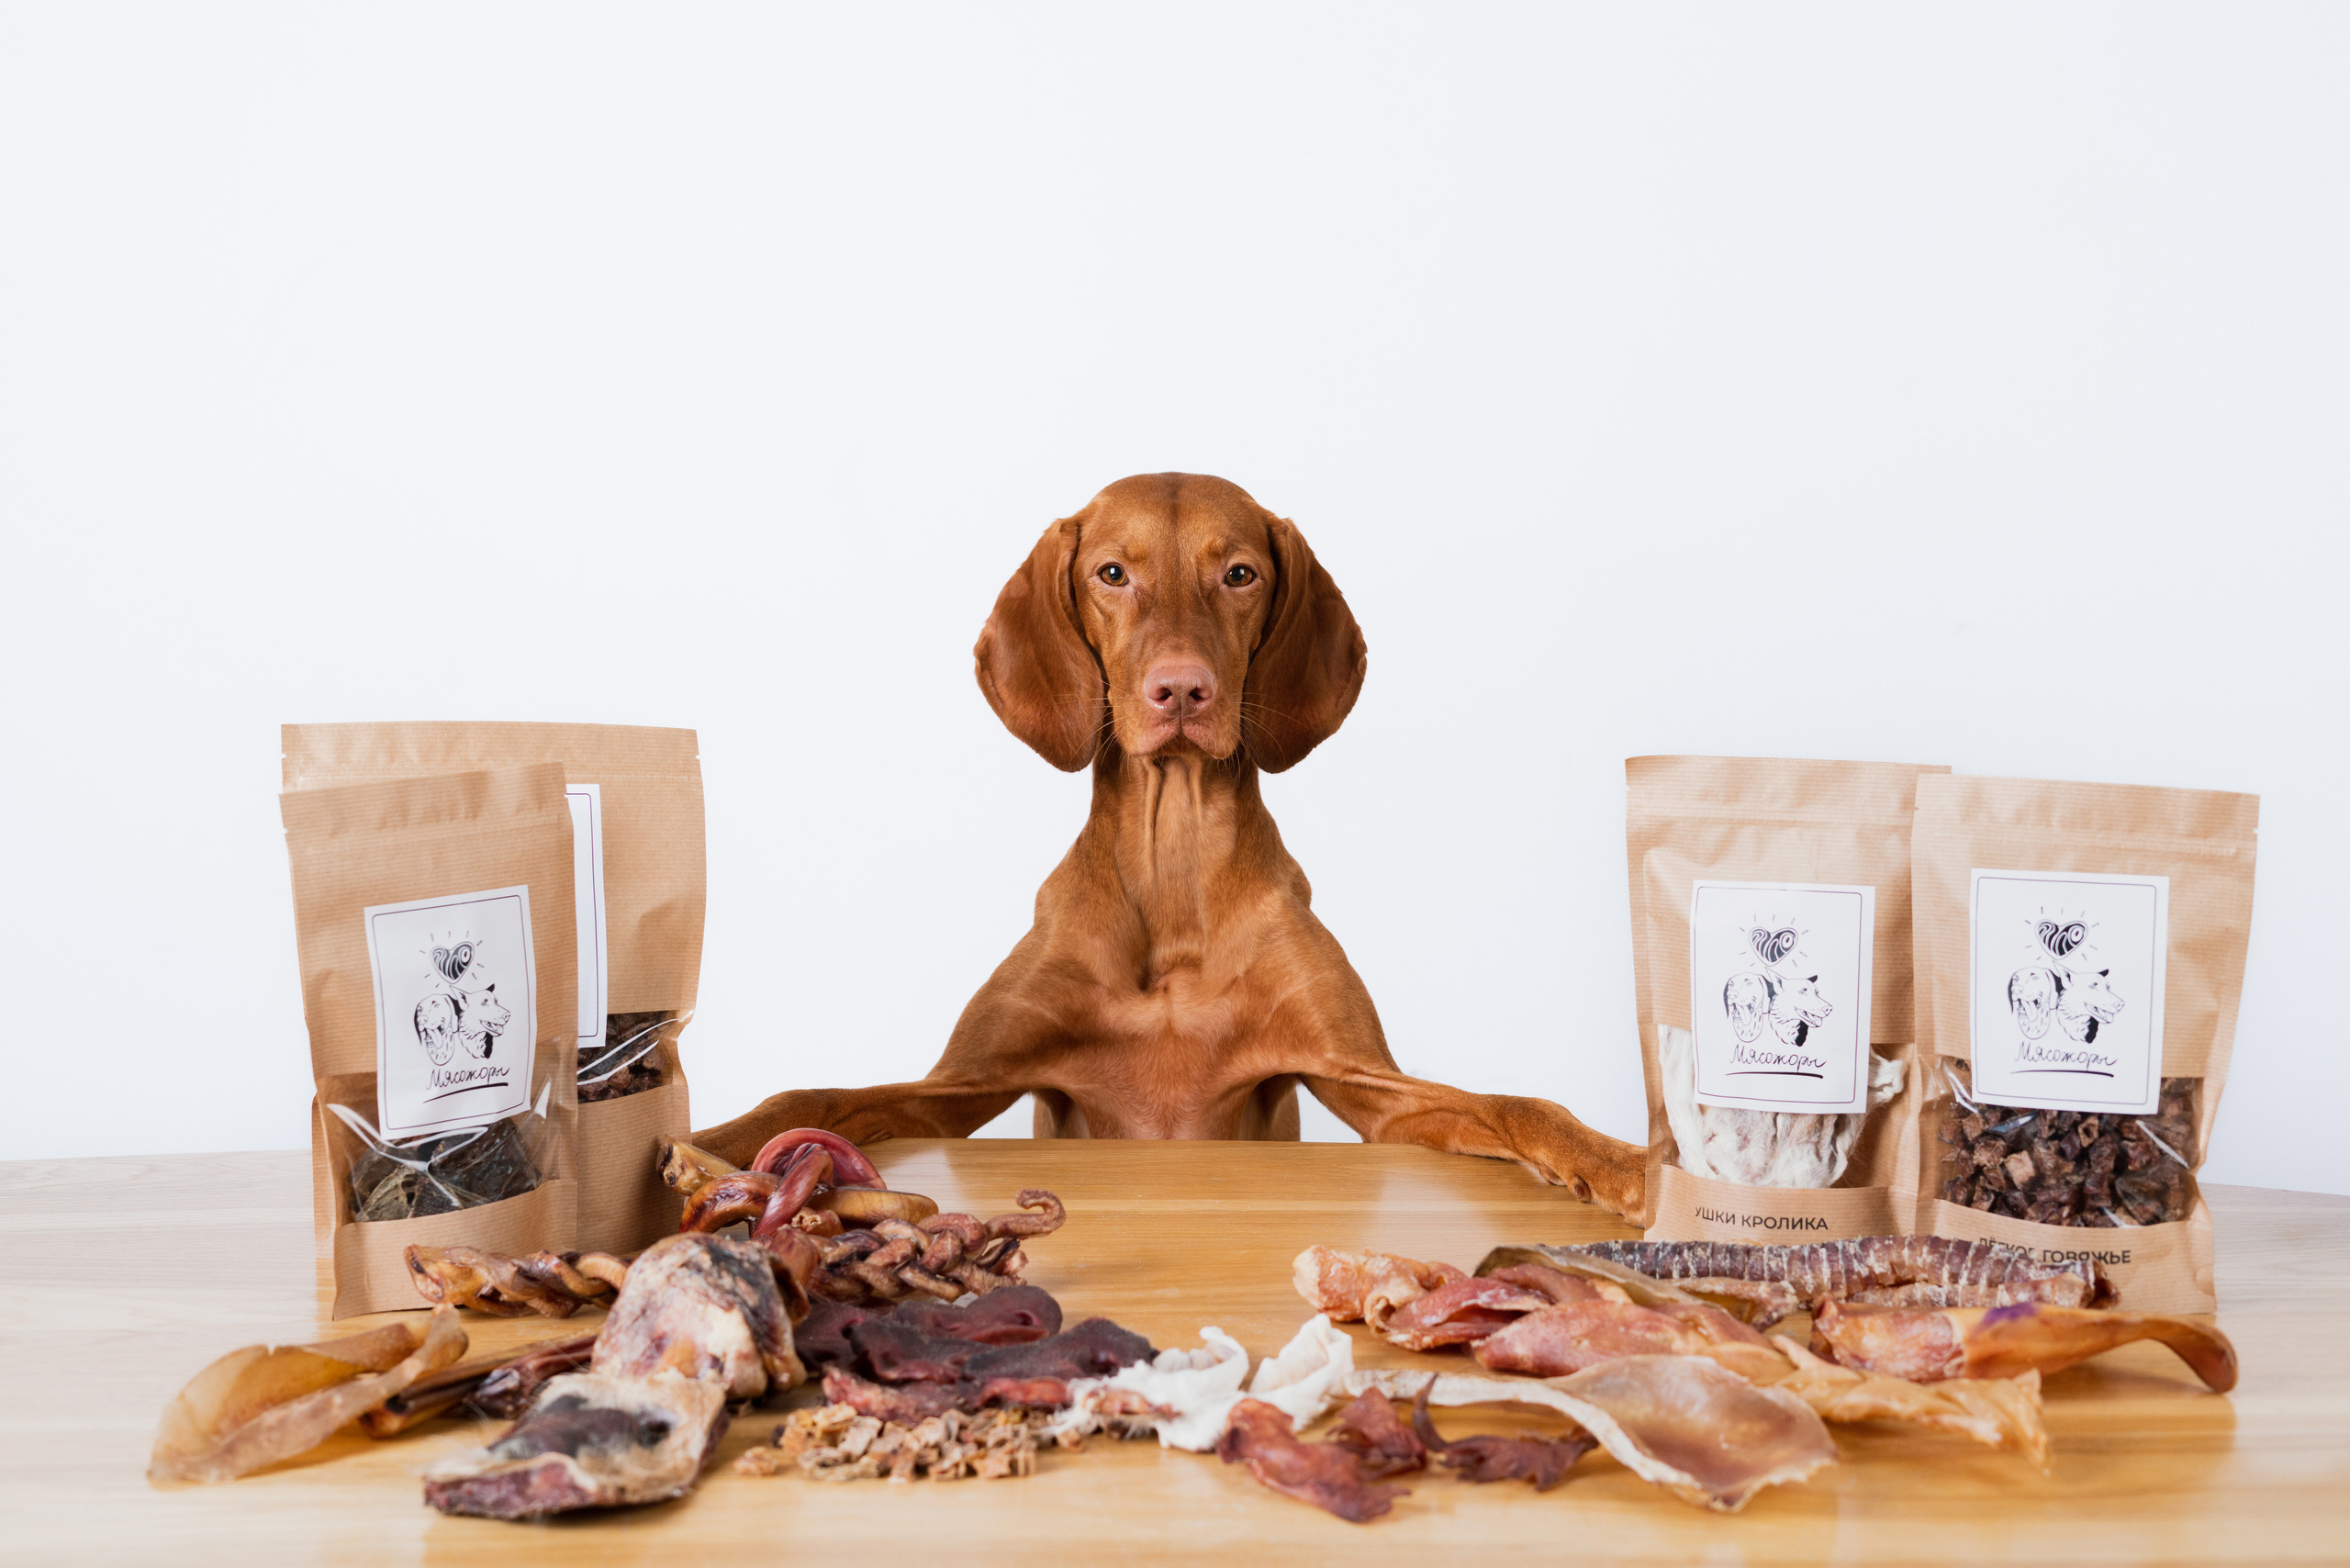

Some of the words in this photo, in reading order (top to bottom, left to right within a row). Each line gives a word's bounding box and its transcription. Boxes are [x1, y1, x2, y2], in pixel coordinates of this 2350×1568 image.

[1729, 1044, 1828, 1072] Мясожоры
[2013, 1041, 2118, 1071] Мясожоры
[426, 1066, 511, 1091] Мясожоры
[1695, 1206, 1736, 1226] УШКИ
[1741, 1214, 1829, 1230] КРОЛИКА
[2042, 1249, 2132, 1265] ГОВЯЖЬЕ
